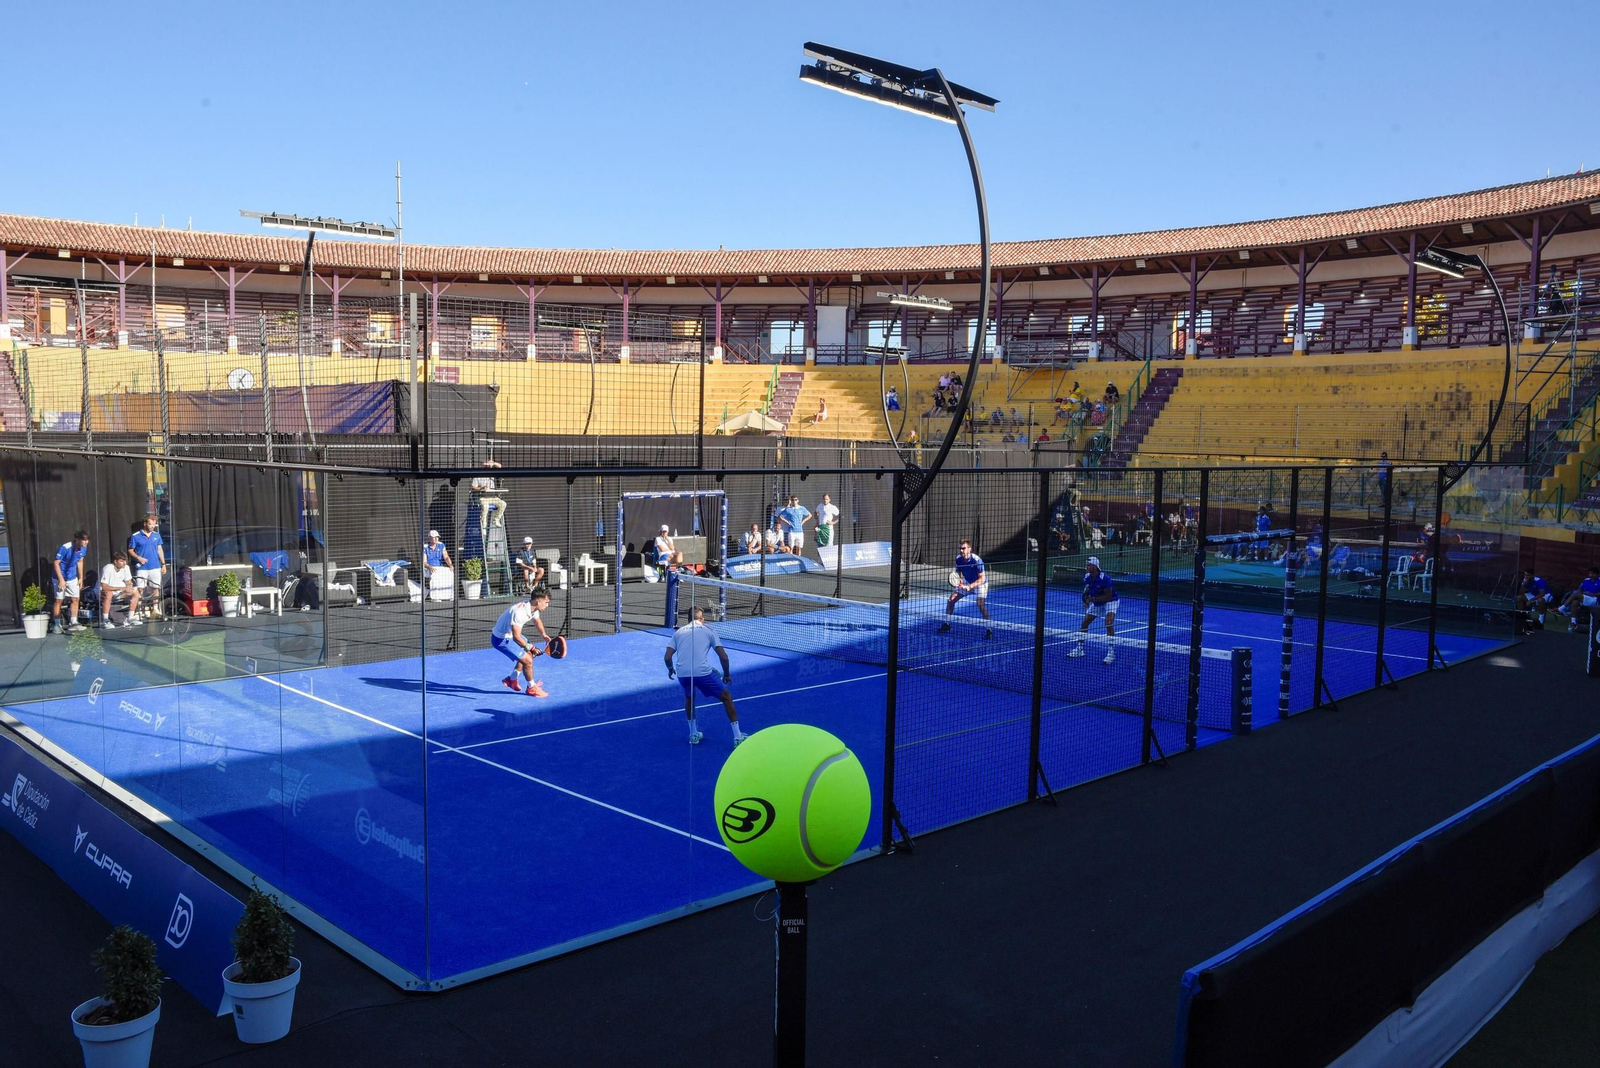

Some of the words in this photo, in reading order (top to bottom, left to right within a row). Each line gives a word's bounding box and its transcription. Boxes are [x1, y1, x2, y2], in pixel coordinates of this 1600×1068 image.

[85, 842, 132, 889] CUPRA
[782, 918, 805, 926] OFFICIAL
[787, 926, 800, 934] BALL
